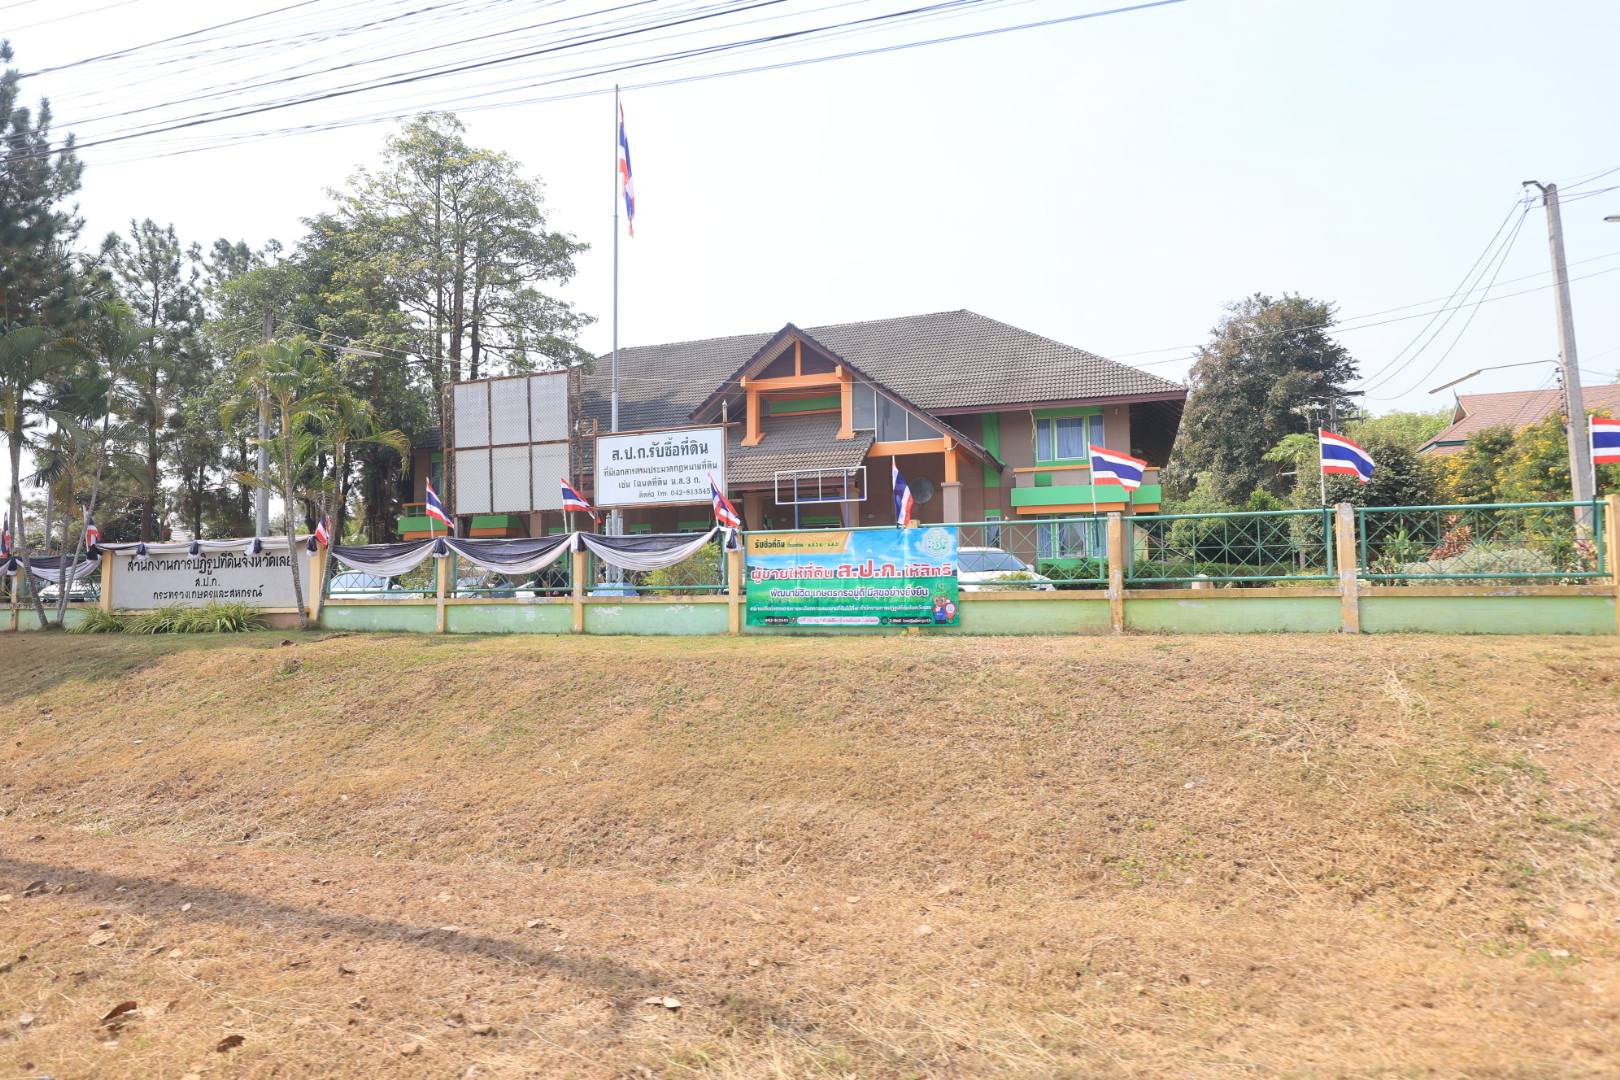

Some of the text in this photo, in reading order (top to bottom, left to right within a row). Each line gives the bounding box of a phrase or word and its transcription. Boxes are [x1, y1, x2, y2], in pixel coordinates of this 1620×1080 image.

[611, 437, 709, 461] ส.ป.ก.รับซื้อที่ดิน
[670, 488, 711, 496] 042-813545
[127, 551, 291, 575] สำนกงานการปฏิรูปที่ดินจังหวัดเลย
[751, 562, 833, 583] ผู้ขายให้ที่ดิน
[837, 559, 902, 577] ส.ป.ก.
[195, 577, 220, 587] ส.ป.ก.
[153, 585, 264, 600] กระทรวงเกษตรและสหกรณ์
